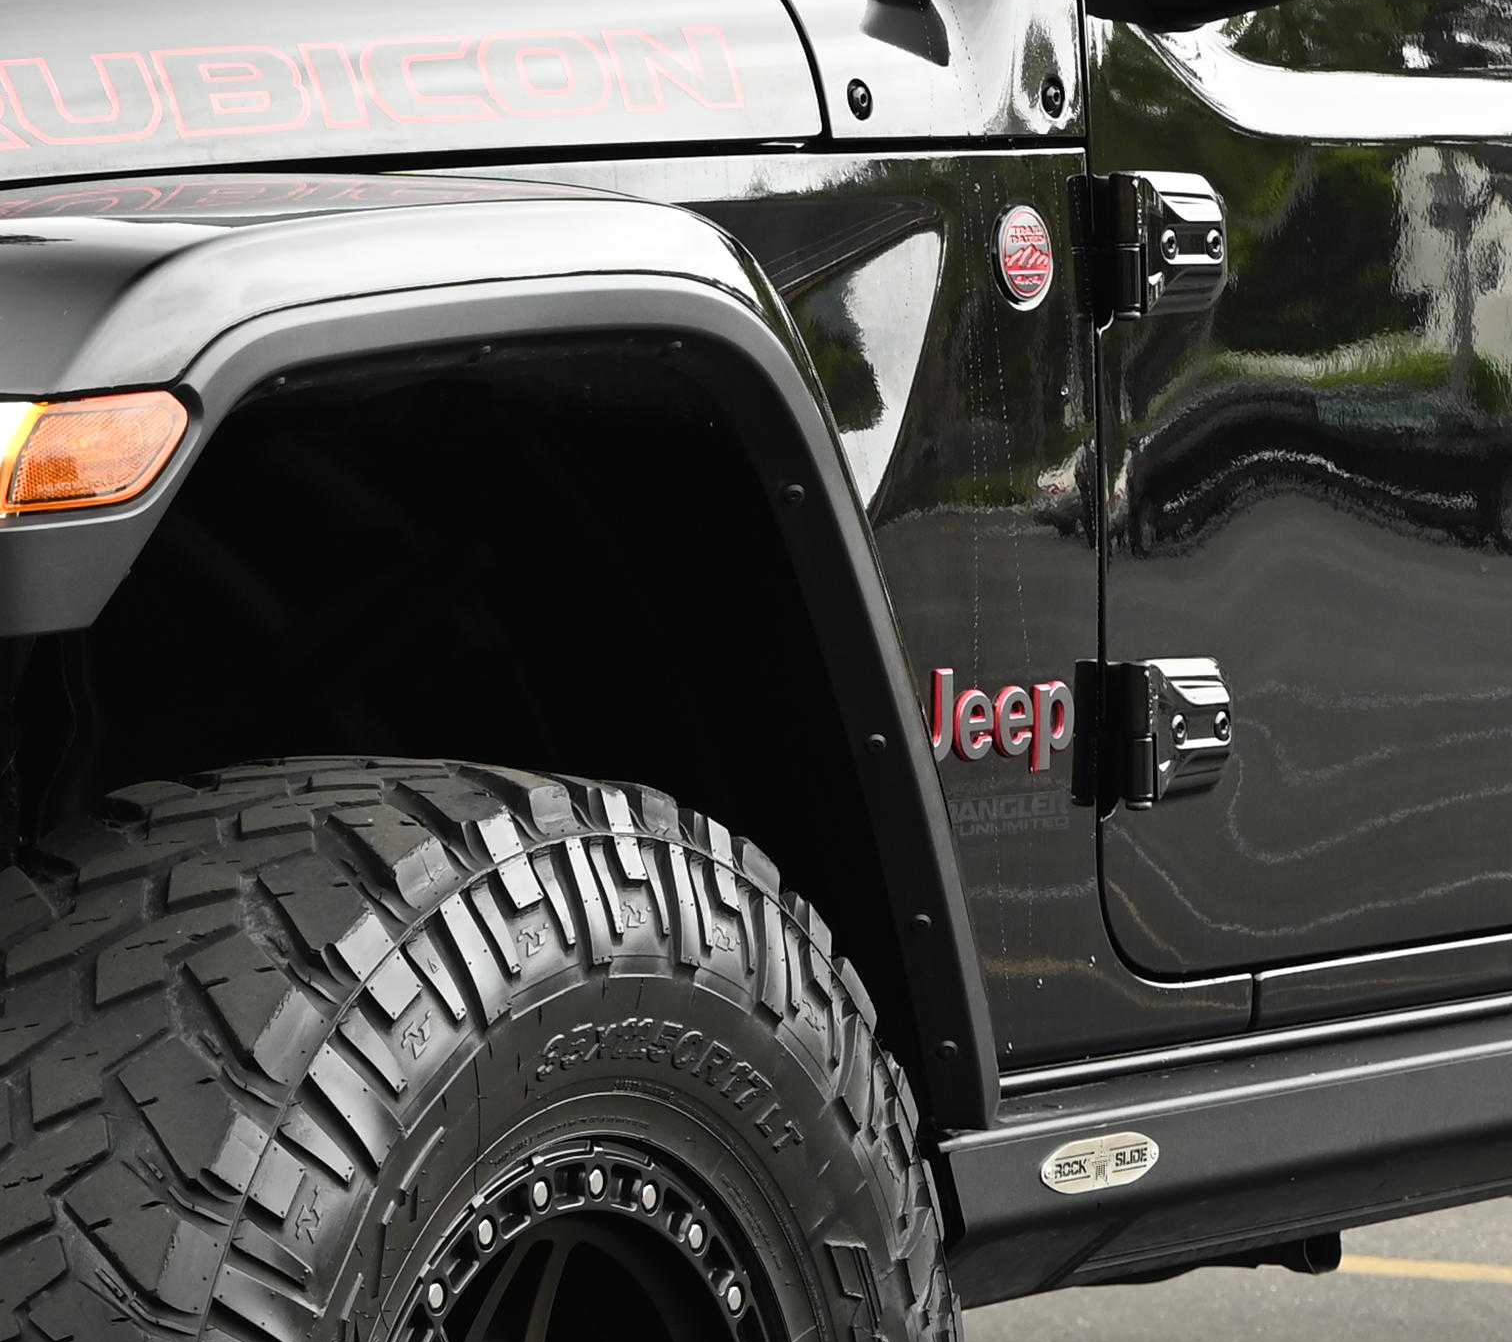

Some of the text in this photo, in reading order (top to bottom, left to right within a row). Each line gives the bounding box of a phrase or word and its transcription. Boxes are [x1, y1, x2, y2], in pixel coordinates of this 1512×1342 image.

[932, 667, 1075, 773] Jeep
[1054, 1147, 1149, 1179] ROCK SLIDE
